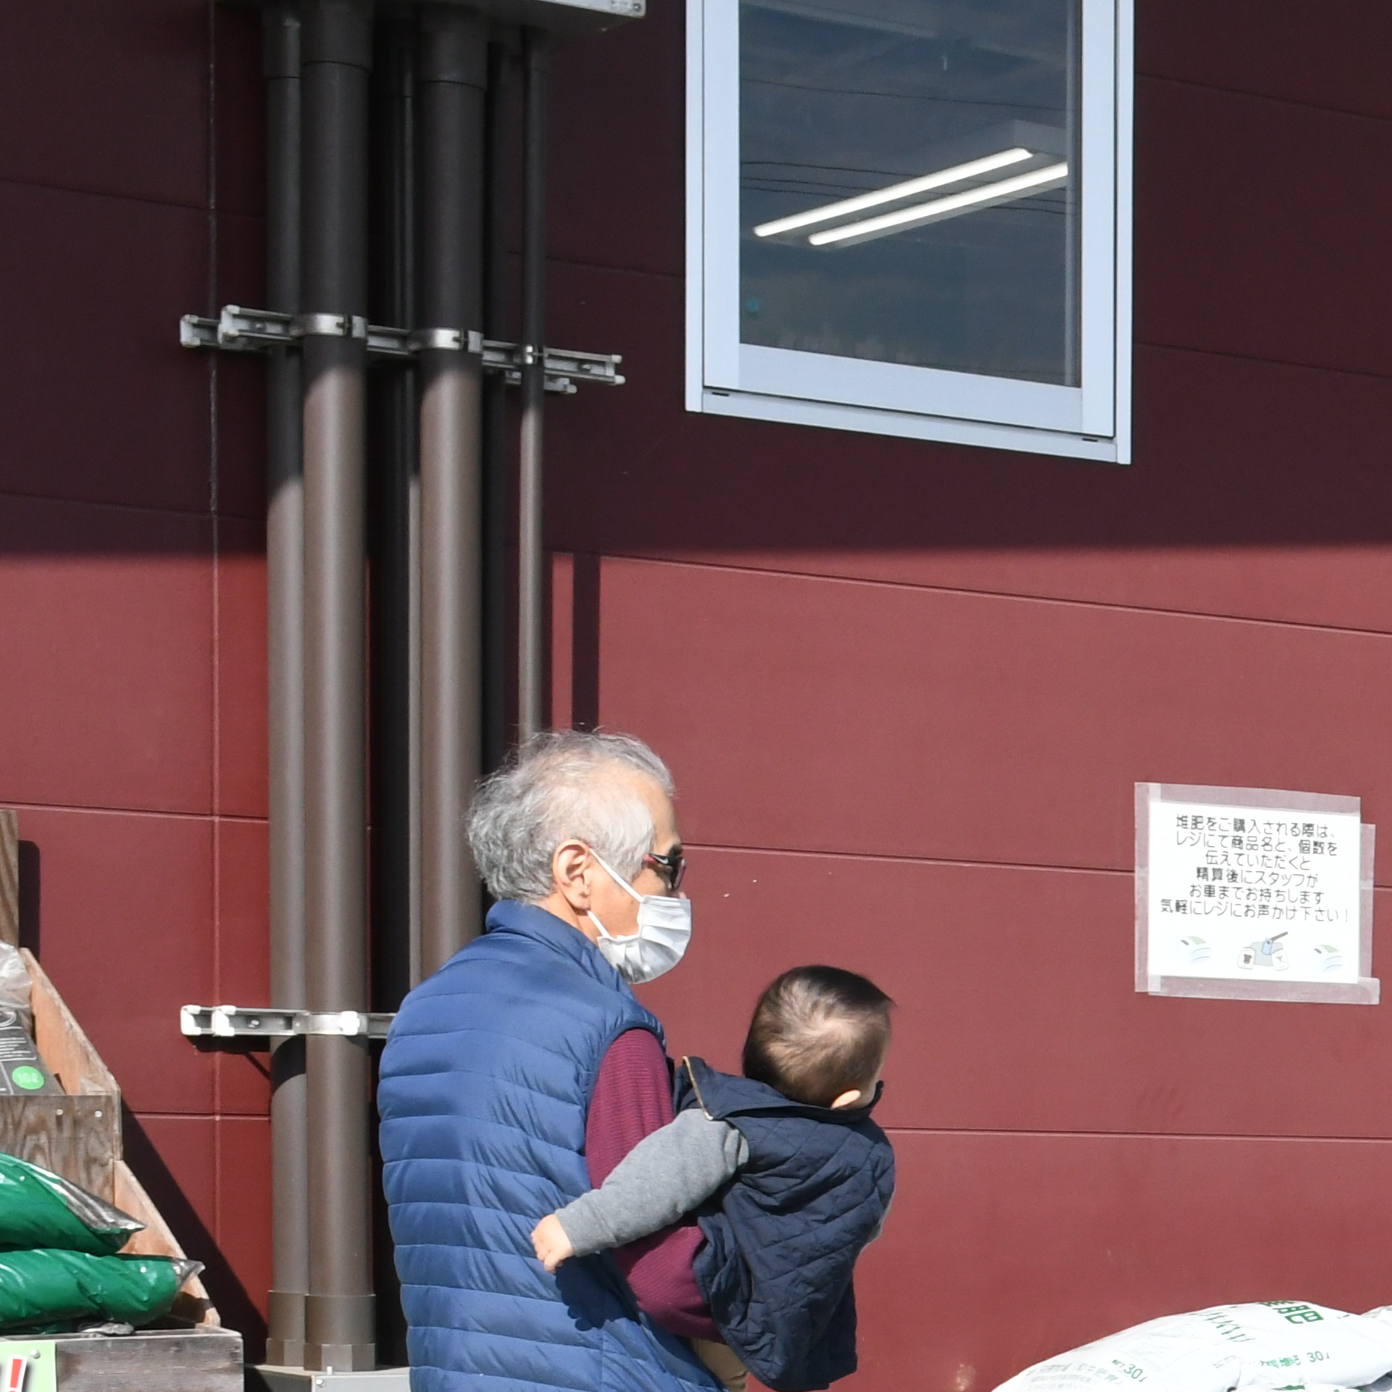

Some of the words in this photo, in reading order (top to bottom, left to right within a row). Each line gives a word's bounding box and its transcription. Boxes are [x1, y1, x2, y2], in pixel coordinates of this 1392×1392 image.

[1176, 814, 1336, 838] 堆肥をご購入される際は、
[1176, 831, 1338, 856] レジにて商品名と、個数を
[1205, 850, 1311, 870] 伝えていただくと
[1196, 866, 1318, 888] 精算後にスタッフが
[1189, 884, 1324, 905] お車までお持ちします
